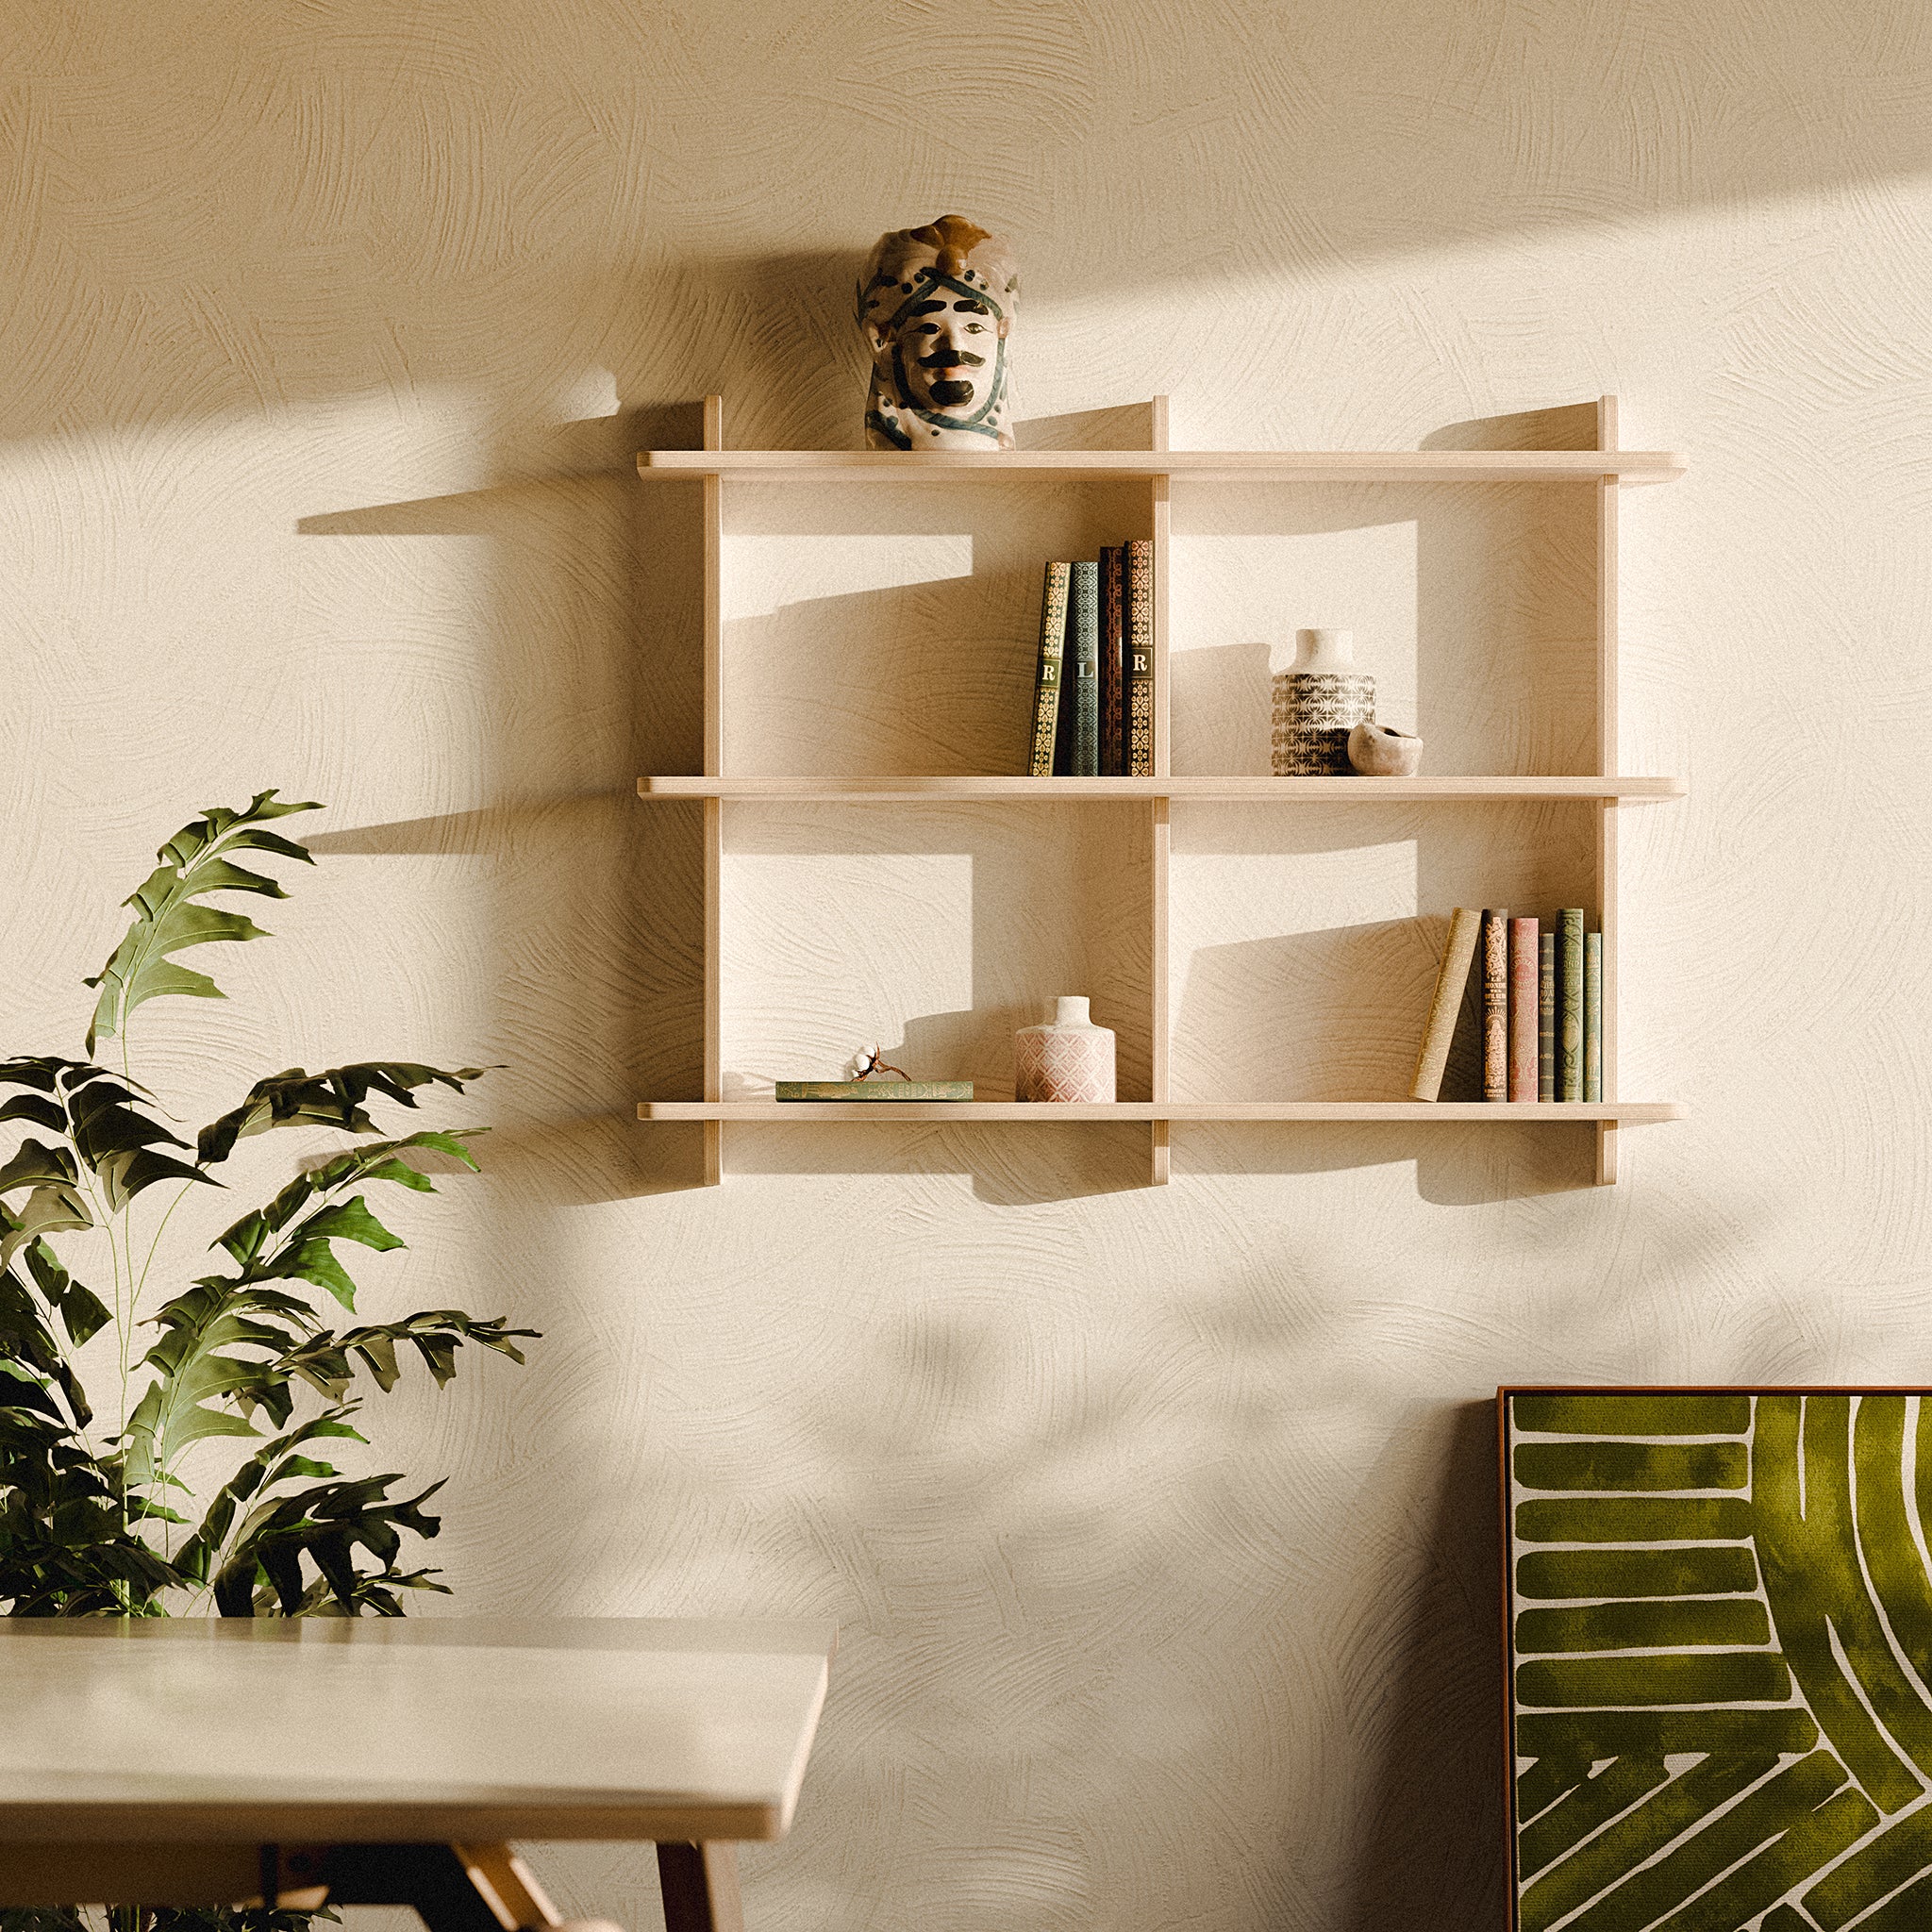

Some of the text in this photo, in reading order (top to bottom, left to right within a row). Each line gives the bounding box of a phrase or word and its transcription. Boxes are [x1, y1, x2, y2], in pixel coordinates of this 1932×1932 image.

[1077, 662, 1093, 677] L
[1133, 655, 1147, 671] R
[1042, 665, 1055, 680] R
